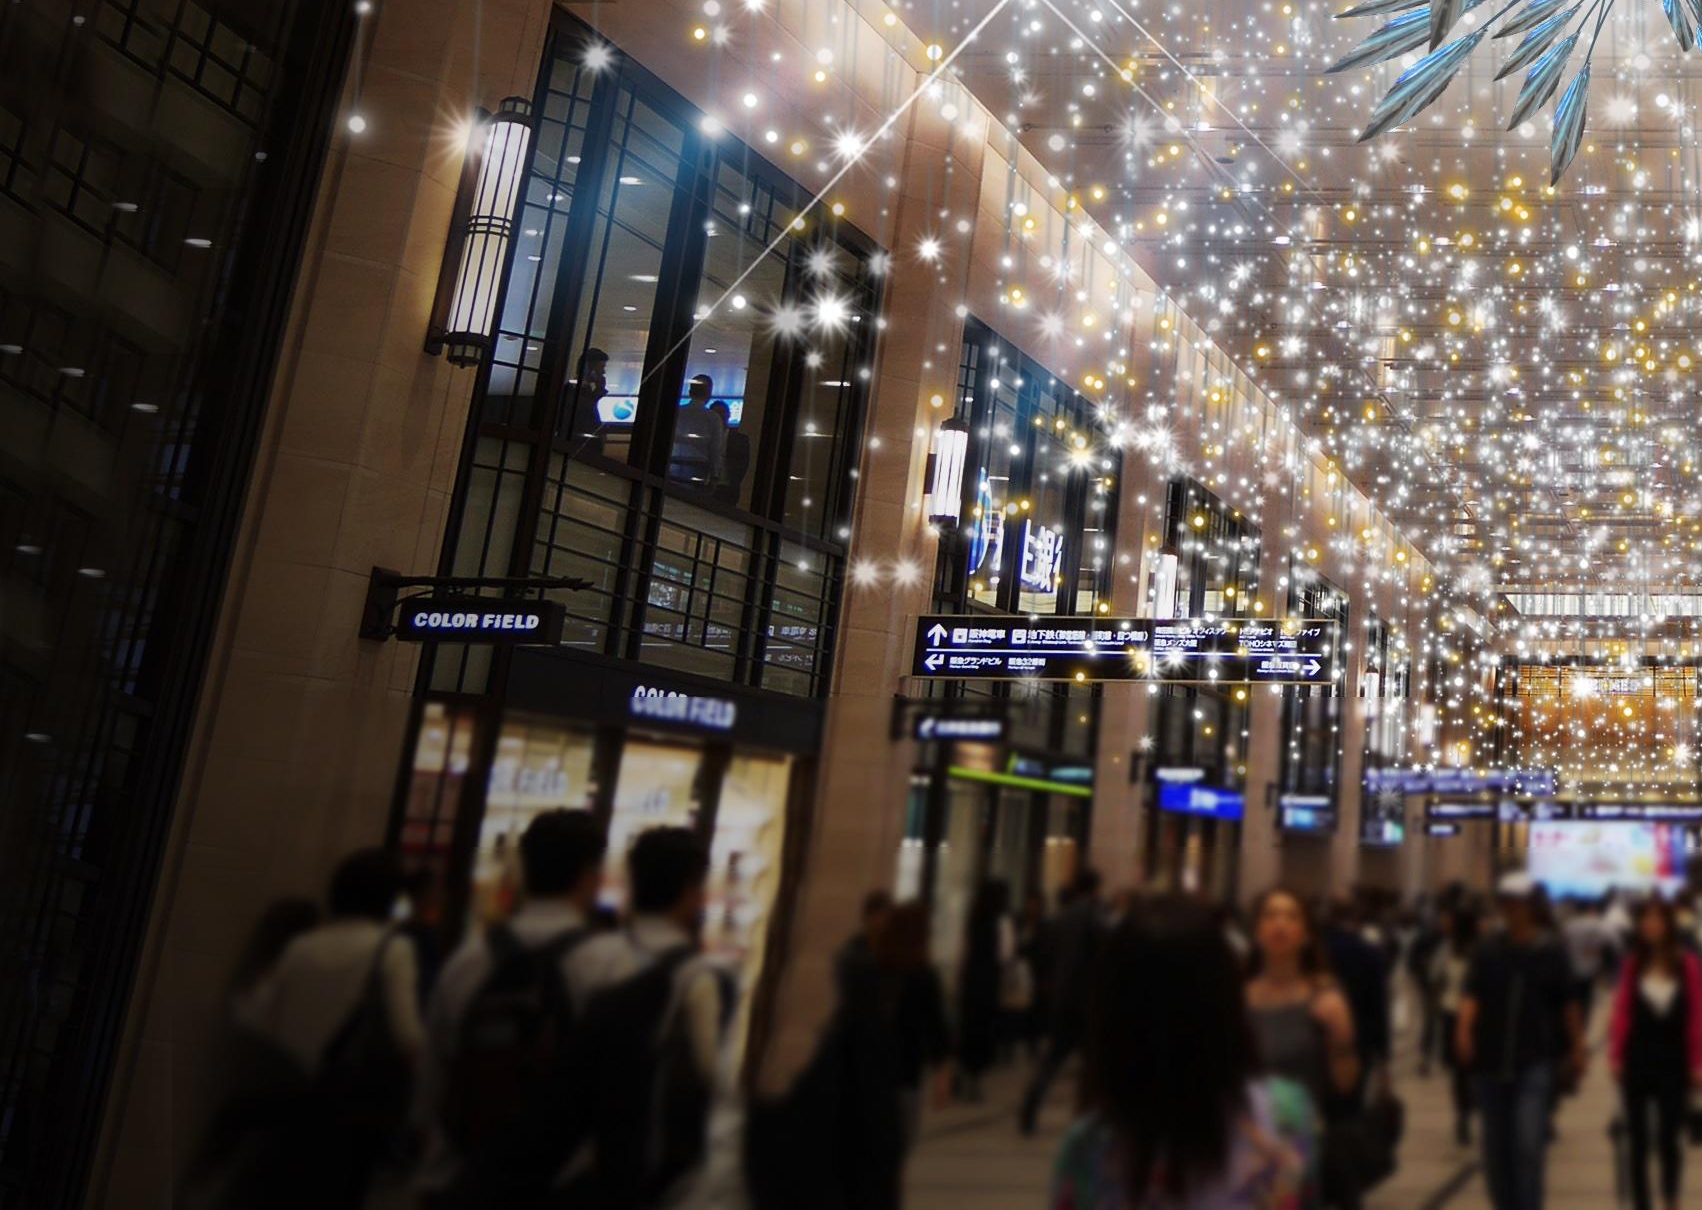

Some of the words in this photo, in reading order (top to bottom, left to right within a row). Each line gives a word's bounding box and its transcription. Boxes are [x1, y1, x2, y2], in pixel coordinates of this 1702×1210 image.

[414, 611, 478, 629] COLOR
[1280, 628, 1321, 637] Hファイブ
